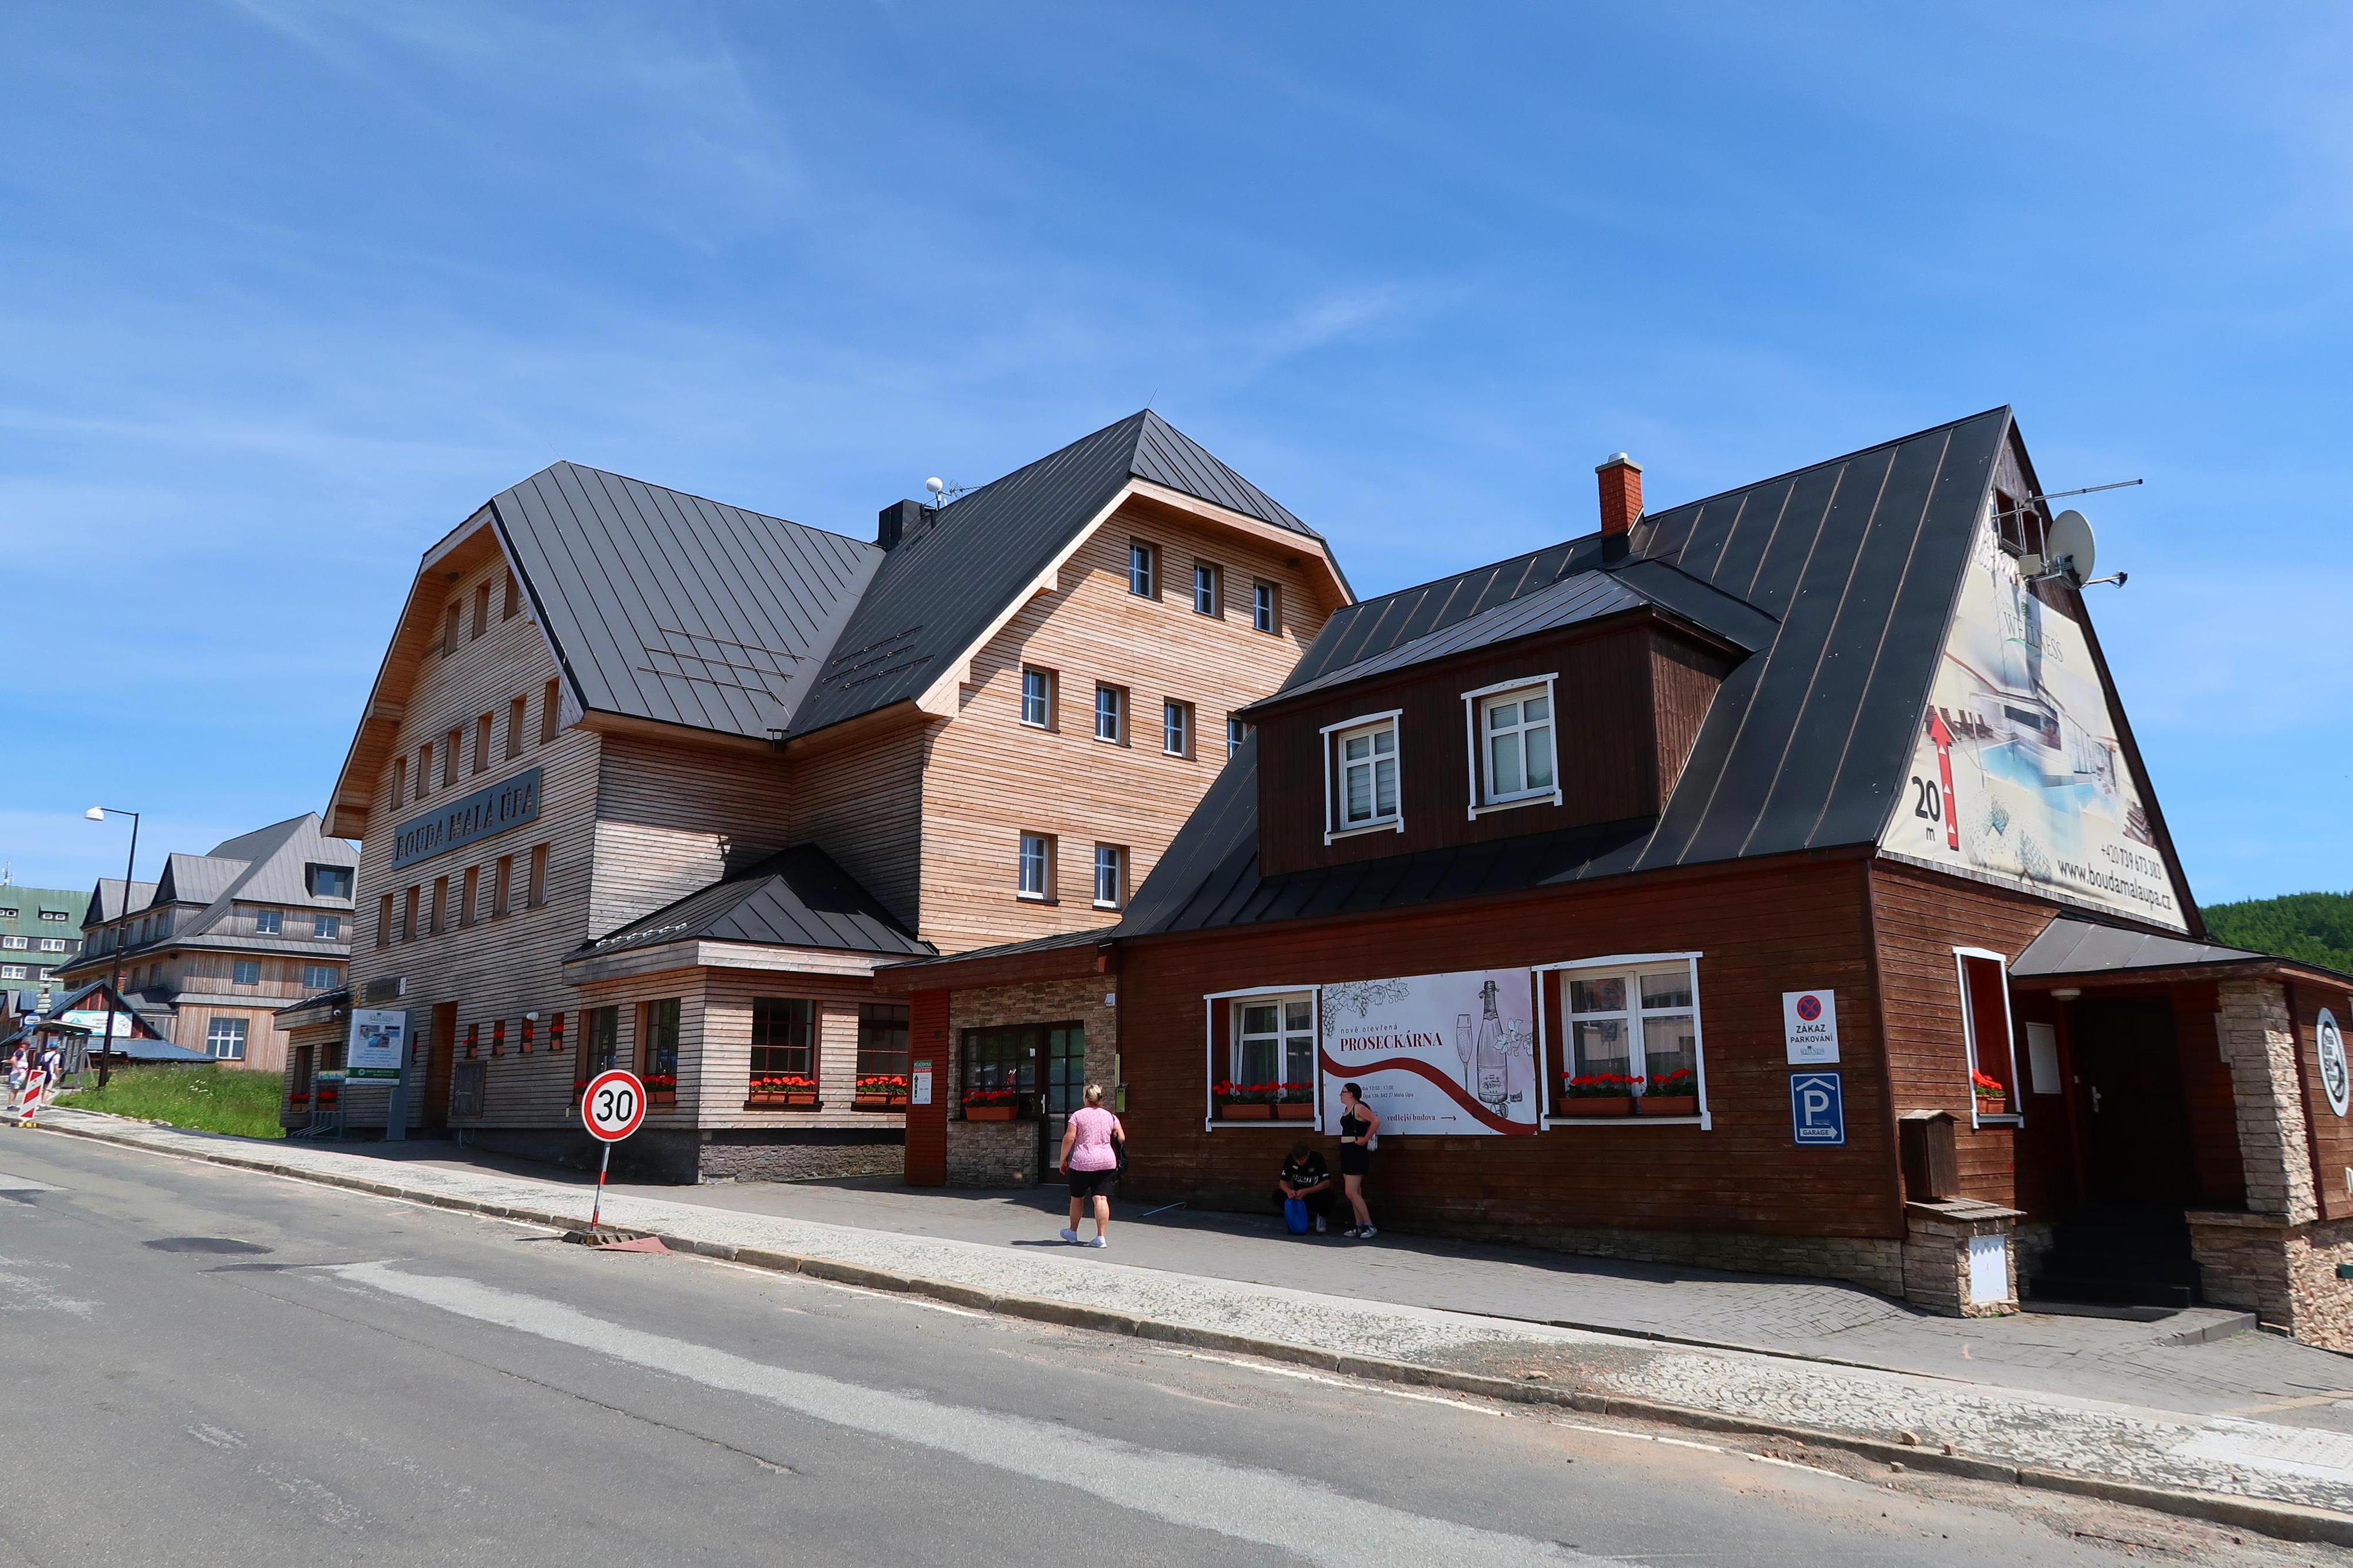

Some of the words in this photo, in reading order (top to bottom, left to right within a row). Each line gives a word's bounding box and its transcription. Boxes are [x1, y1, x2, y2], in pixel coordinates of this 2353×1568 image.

[2002, 611, 2064, 663] WELLNESS
[1911, 776, 1941, 822] 20
[395, 819, 444, 861] BOUDA
[448, 793, 494, 842] MALÁ
[499, 783, 533, 822] ÚPA
[1925, 827, 1935, 842] m
[2101, 844, 2119, 864] +420
[2119, 848, 2133, 869] 739
[2135, 854, 2148, 875] 673
[2148, 859, 2162, 880] 383
[2057, 860, 2172, 910] www.boudamalaupa.cz
[1340, 1030, 1443, 1052] PROSECKÁRNA
[1362, 1023, 1398, 1033] otevřená
[1790, 1033, 1833, 1043] PARKOVÁNÍ
[1796, 1023, 1826, 1033] ZÁKAZ
[596, 1089, 633, 1122] 30
[1387, 1113, 1412, 1122] vedlejší
[1804, 1090, 1829, 1126] P
